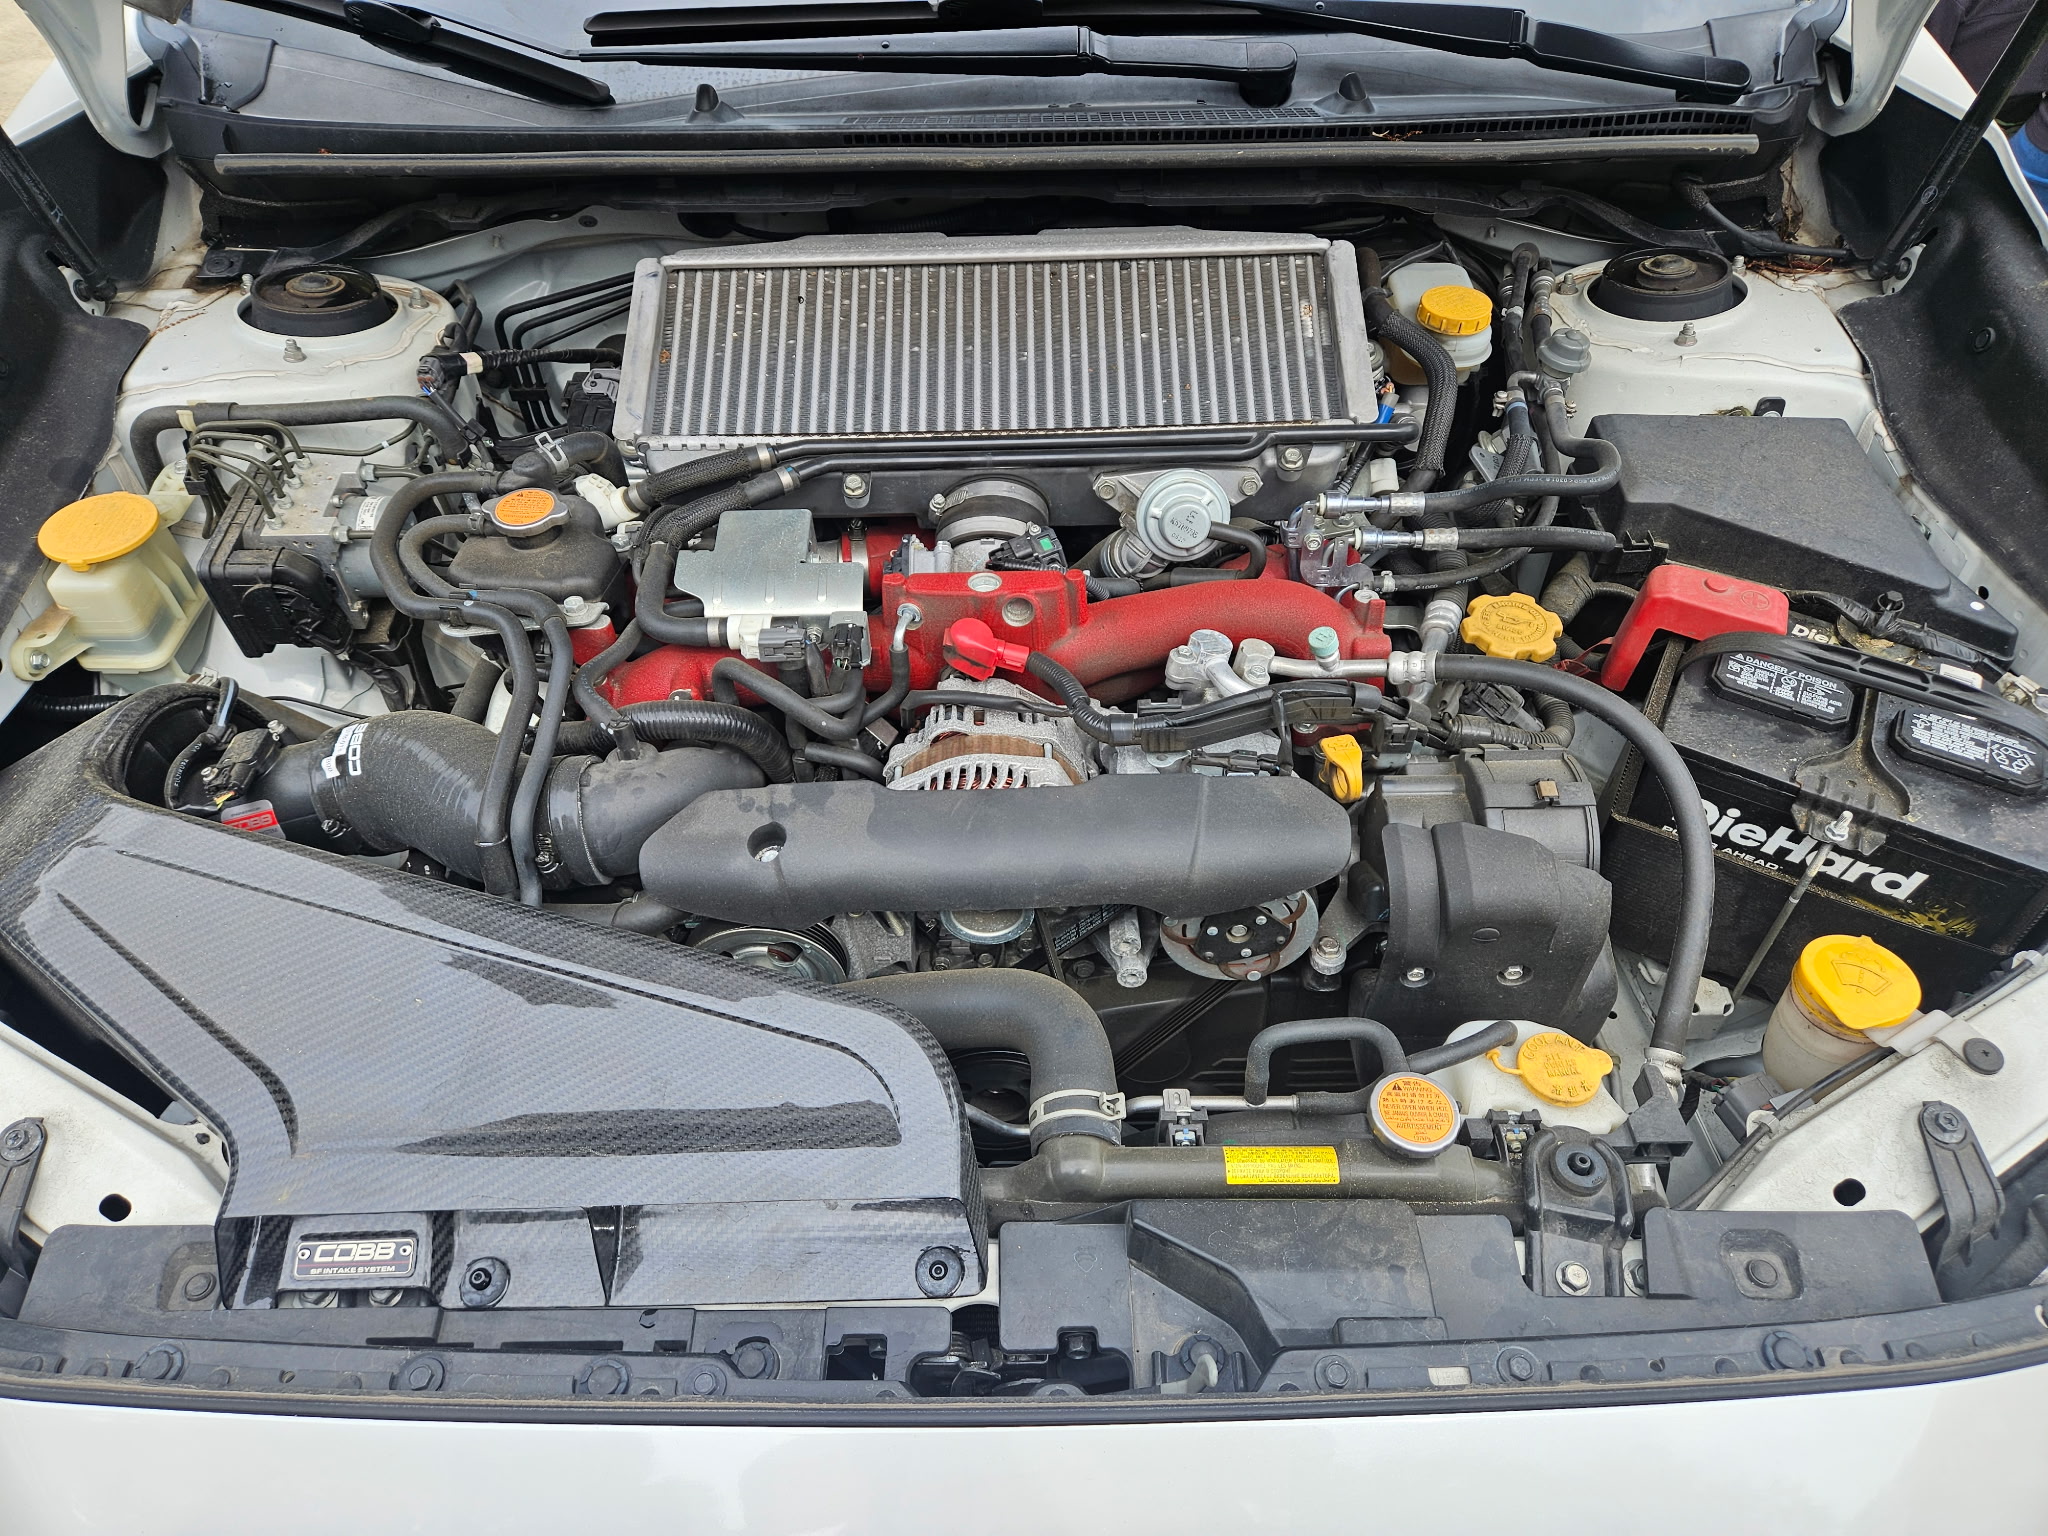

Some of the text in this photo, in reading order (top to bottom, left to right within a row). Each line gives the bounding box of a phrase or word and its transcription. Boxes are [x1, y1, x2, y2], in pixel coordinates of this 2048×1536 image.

[1745, 655, 1788, 674] DANGER
[1798, 672, 1837, 690] POISON
[348, 723, 369, 776] COBB
[1721, 847, 1779, 871] AHEAD
[1522, 1034, 1586, 1060] COOLANT
[314, 1242, 396, 1262] COBB
[357, 1265, 396, 1273] SYSTEM
